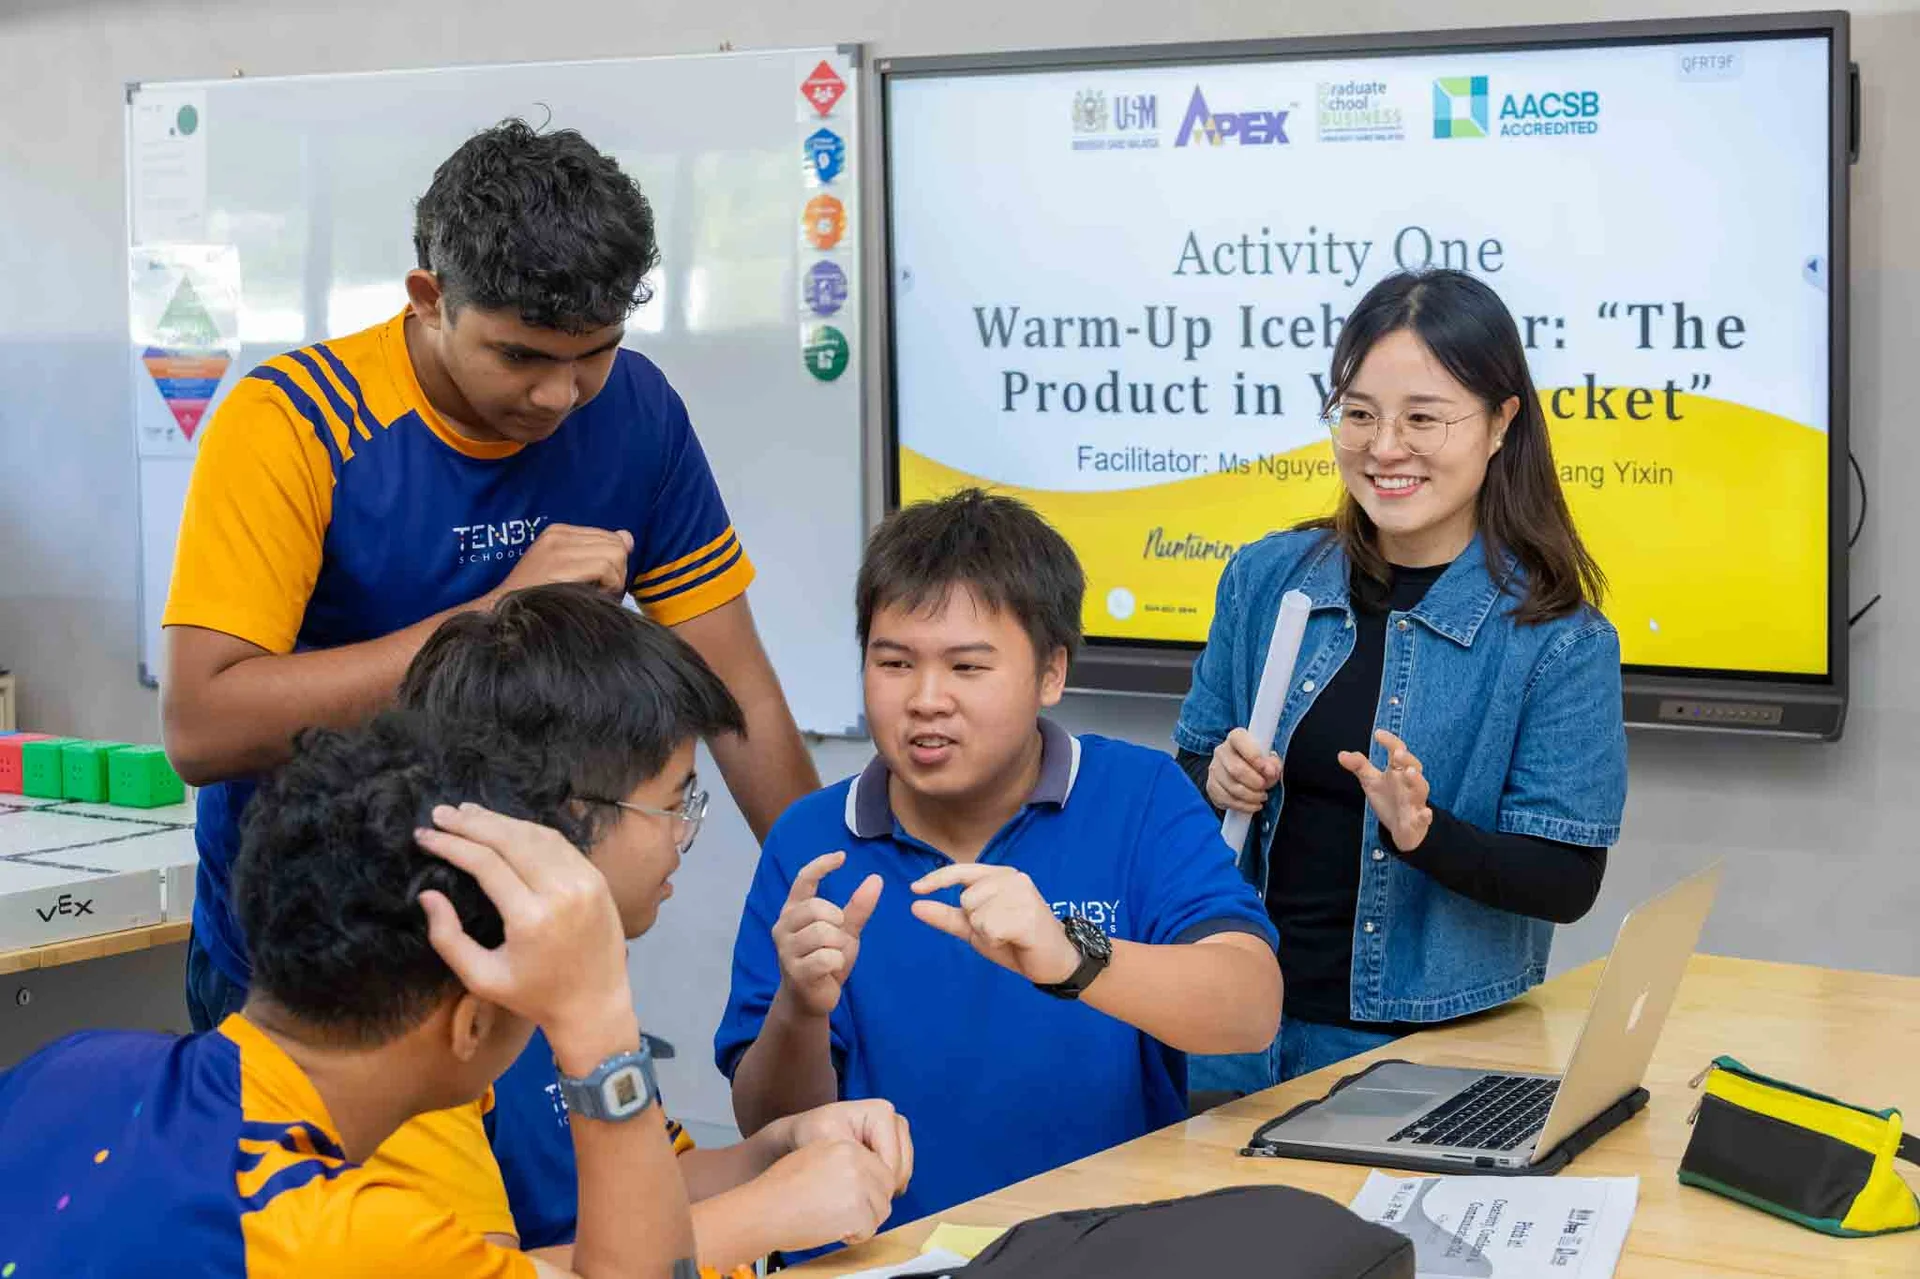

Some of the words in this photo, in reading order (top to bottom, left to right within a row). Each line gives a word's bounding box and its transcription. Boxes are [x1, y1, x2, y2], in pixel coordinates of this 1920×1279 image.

[1174, 83, 1291, 148] APEX
[1500, 91, 1600, 120] AACSB
[1500, 121, 1598, 137] ACCREDITED
[1172, 225, 1374, 287] Activity
[1393, 225, 1505, 273] One
[972, 304, 1212, 361] Warm-Up
[1001, 370, 1209, 415] Product
[1233, 371, 1284, 416] in
[1077, 446, 1209, 474] Facilitator:
[1219, 451, 1250, 474] Ms
[1613, 460, 1674, 485] Yixin
[452, 516, 542, 552] TENBY
[459, 548, 525, 564] SCHOOL
[35, 893, 95, 923] VEX
[1050, 899, 1120, 924] ENBY
